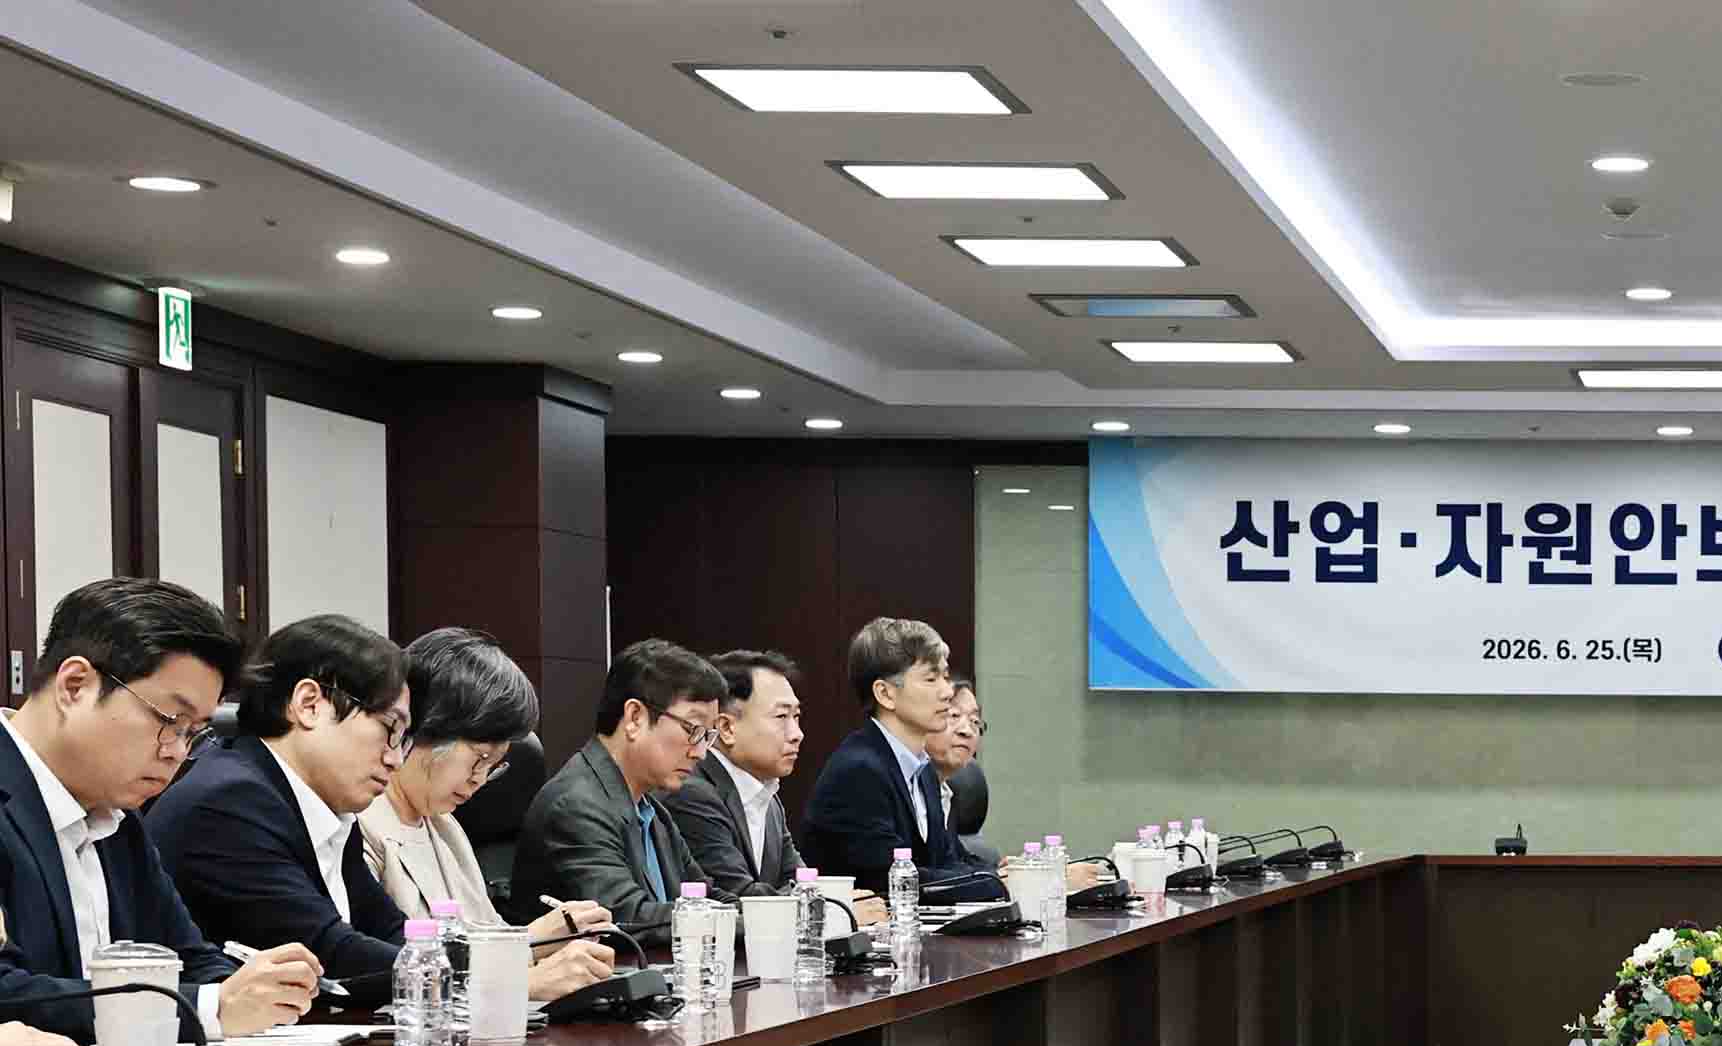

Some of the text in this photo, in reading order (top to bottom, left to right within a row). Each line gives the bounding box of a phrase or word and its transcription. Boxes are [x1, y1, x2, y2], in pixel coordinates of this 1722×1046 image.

[1482, 637, 1662, 664] 2026. 6. 25.(목)
